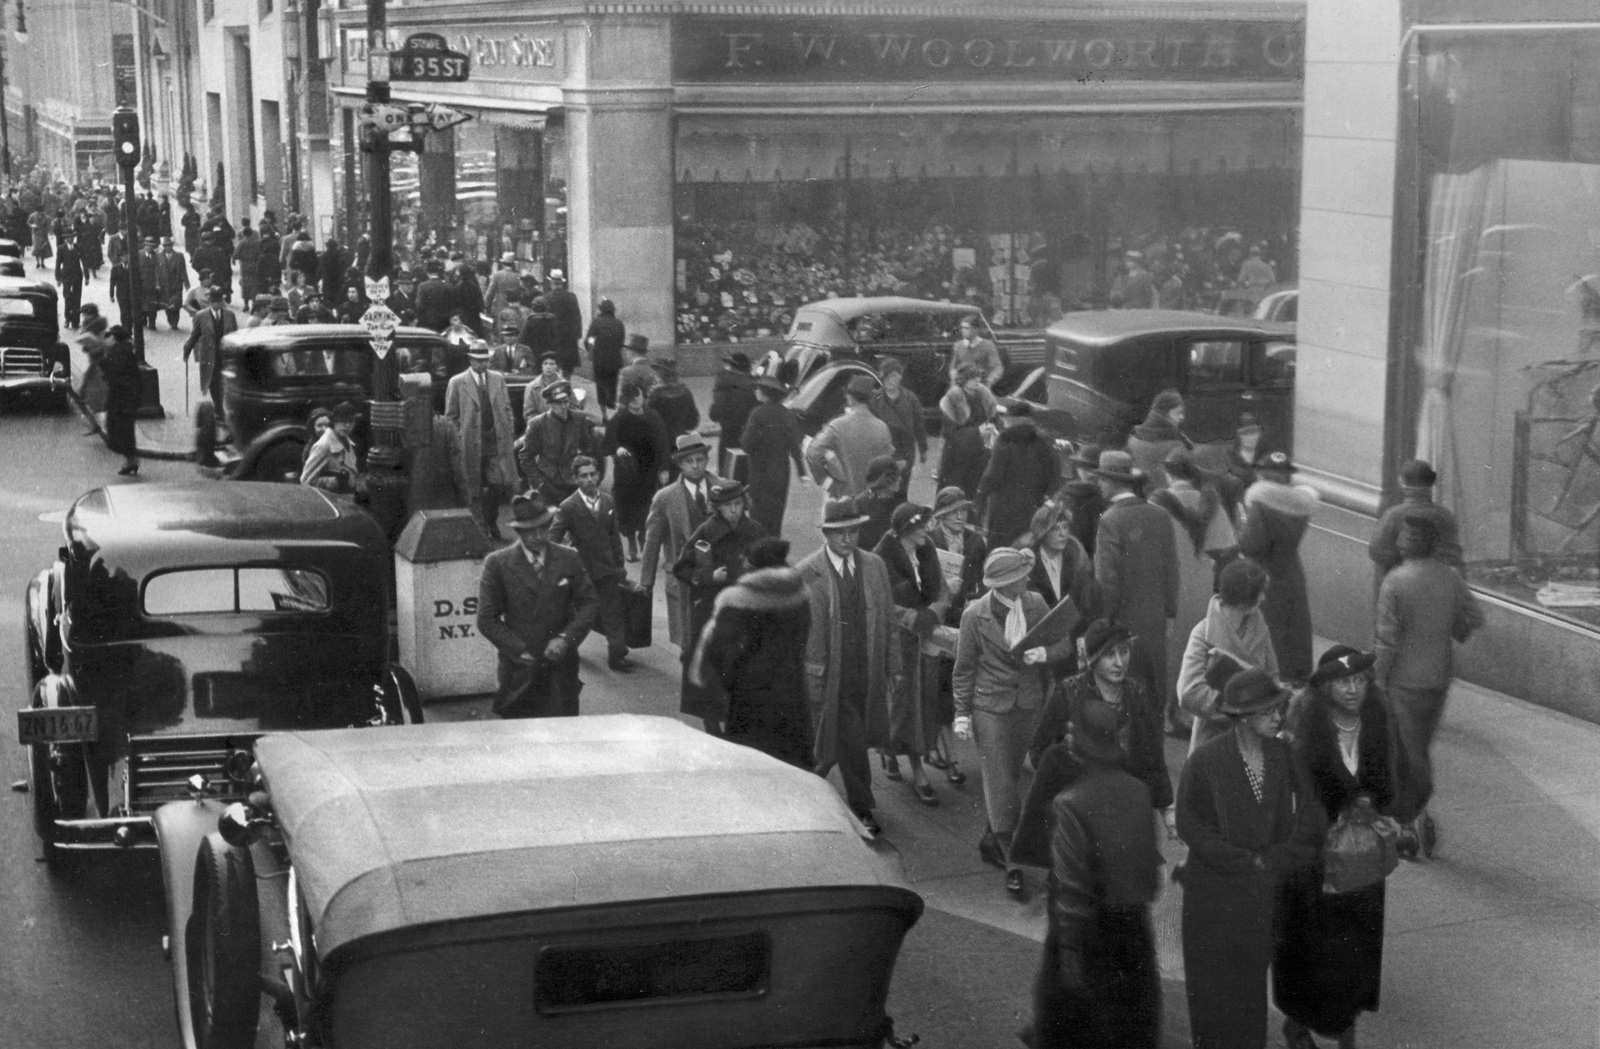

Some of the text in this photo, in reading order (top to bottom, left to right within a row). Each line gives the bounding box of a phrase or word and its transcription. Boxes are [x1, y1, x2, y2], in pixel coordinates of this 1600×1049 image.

[720, 33, 764, 68] F.
[792, 33, 848, 65] W.
[865, 33, 1238, 69] WOOLWORTH
[413, 57, 440, 77] 35
[442, 58, 465, 77] ST
[364, 311, 396, 322] PARKING
